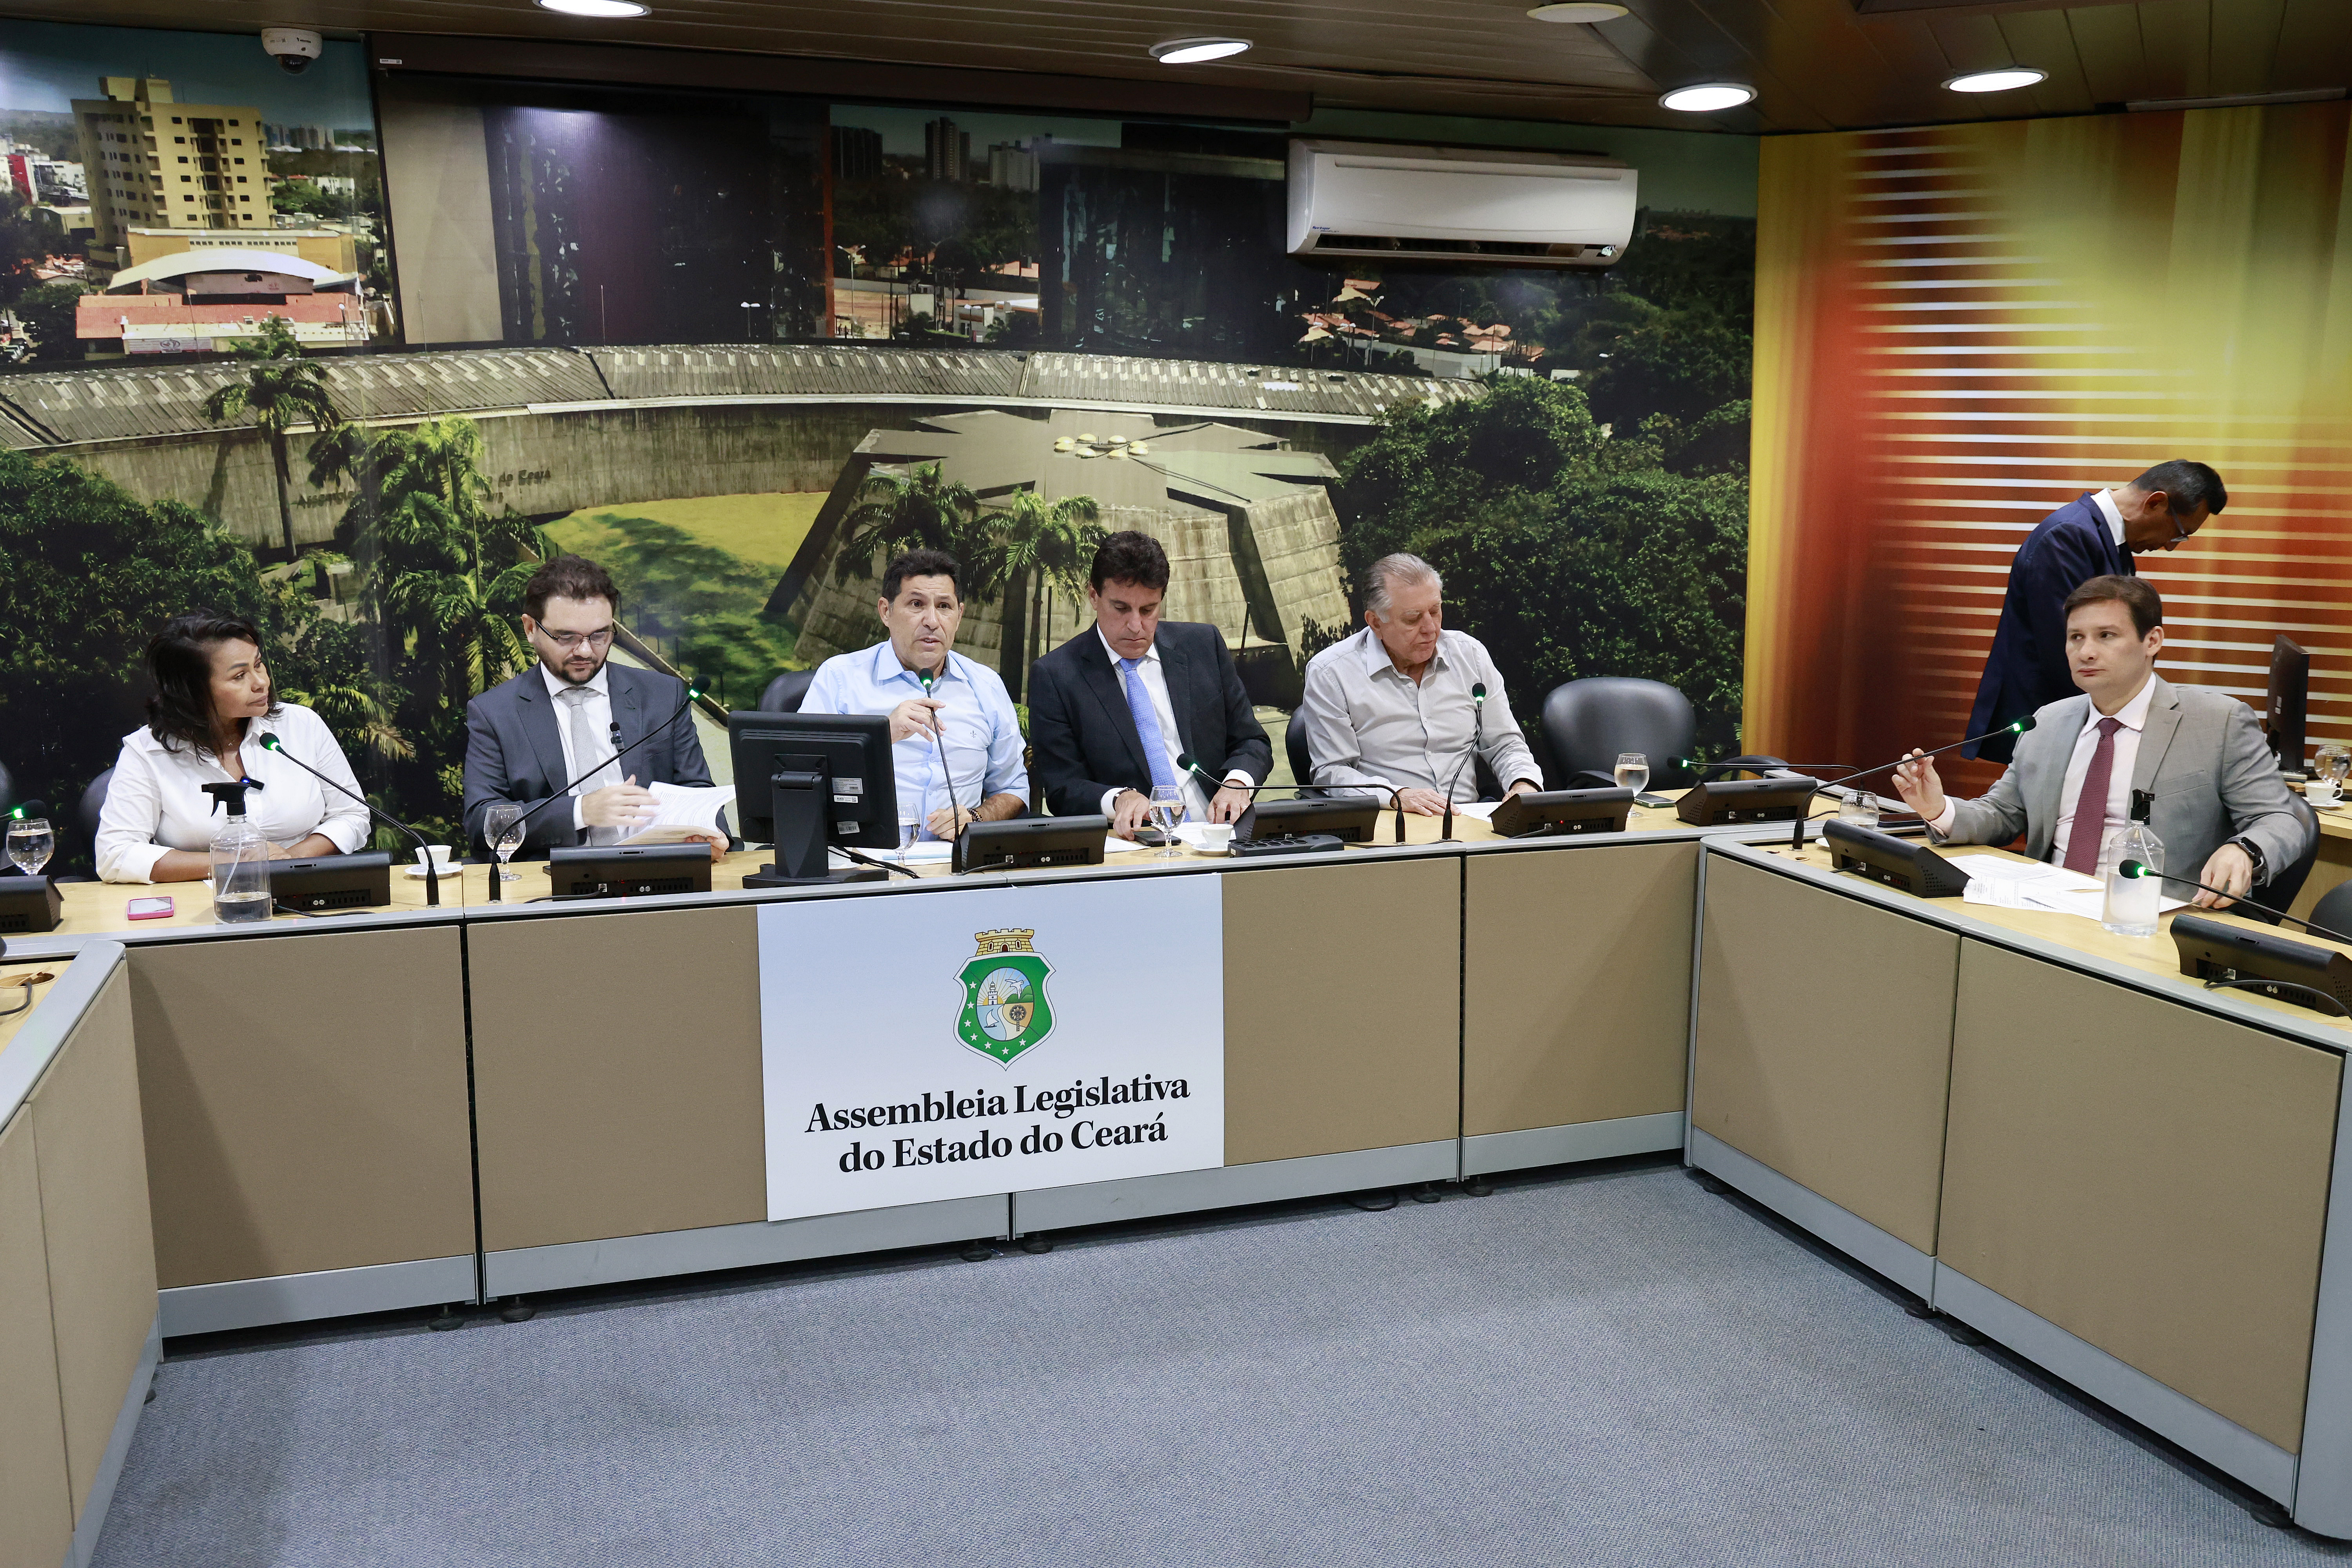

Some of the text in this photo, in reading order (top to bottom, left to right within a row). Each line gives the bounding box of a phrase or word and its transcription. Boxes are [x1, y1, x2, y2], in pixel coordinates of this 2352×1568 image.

[804, 1074, 1191, 1133] Assembleia Legislativa
[839, 1112, 1168, 1172] do Estado do Ceará
